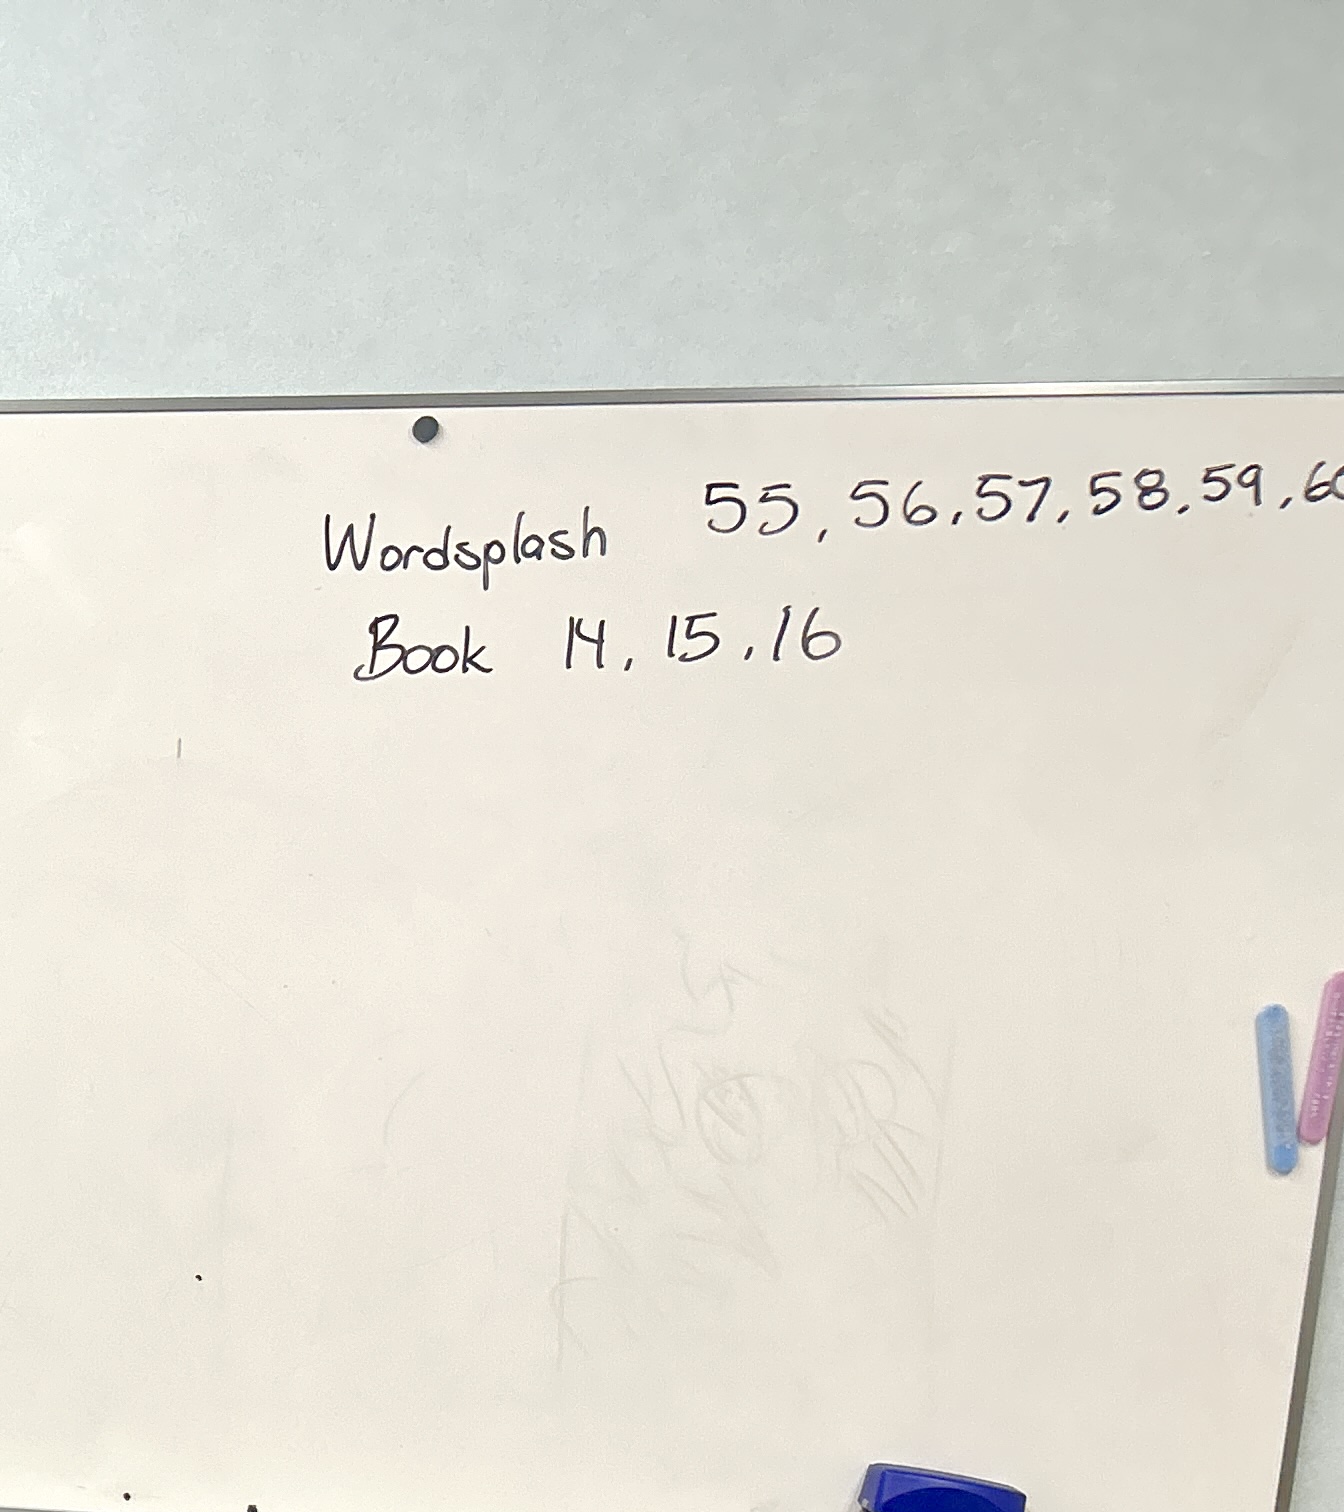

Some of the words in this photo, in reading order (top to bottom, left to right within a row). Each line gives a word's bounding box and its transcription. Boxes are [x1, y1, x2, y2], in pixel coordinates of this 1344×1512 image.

[324, 504, 608, 592] Wordsplash
[353, 612, 494, 682] Book
[772, 605, 843, 663] 16
